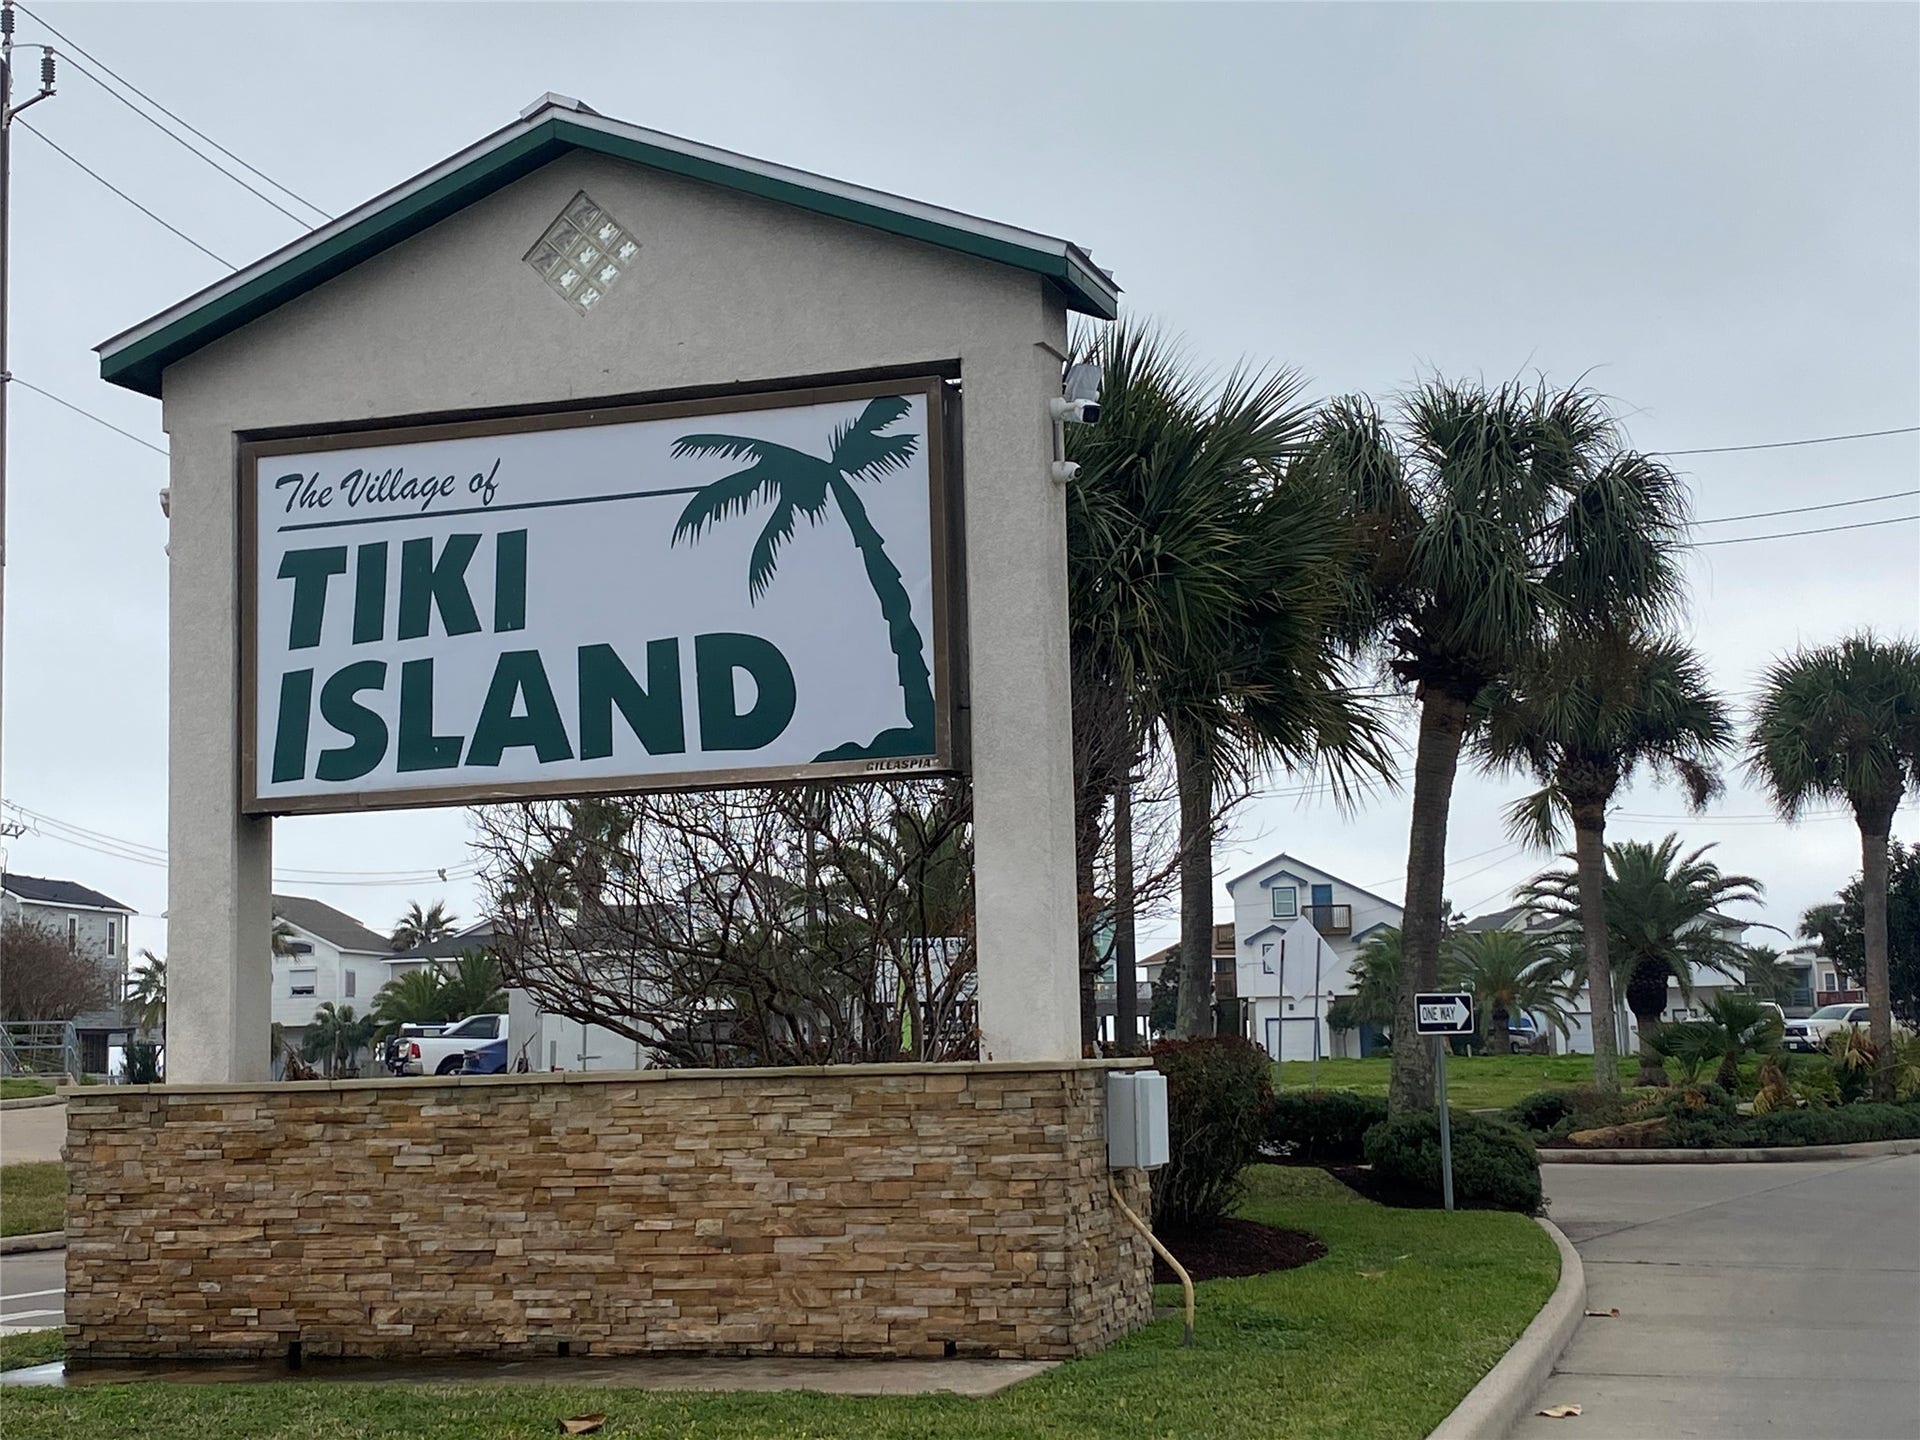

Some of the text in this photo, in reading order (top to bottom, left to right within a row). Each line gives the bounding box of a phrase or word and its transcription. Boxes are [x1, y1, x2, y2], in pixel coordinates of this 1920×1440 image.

[275, 457, 501, 513] The Village of
[276, 528, 528, 651] TIKI
[271, 632, 797, 784] ISLAND
[1421, 1006, 1456, 1021] ONE WAY
